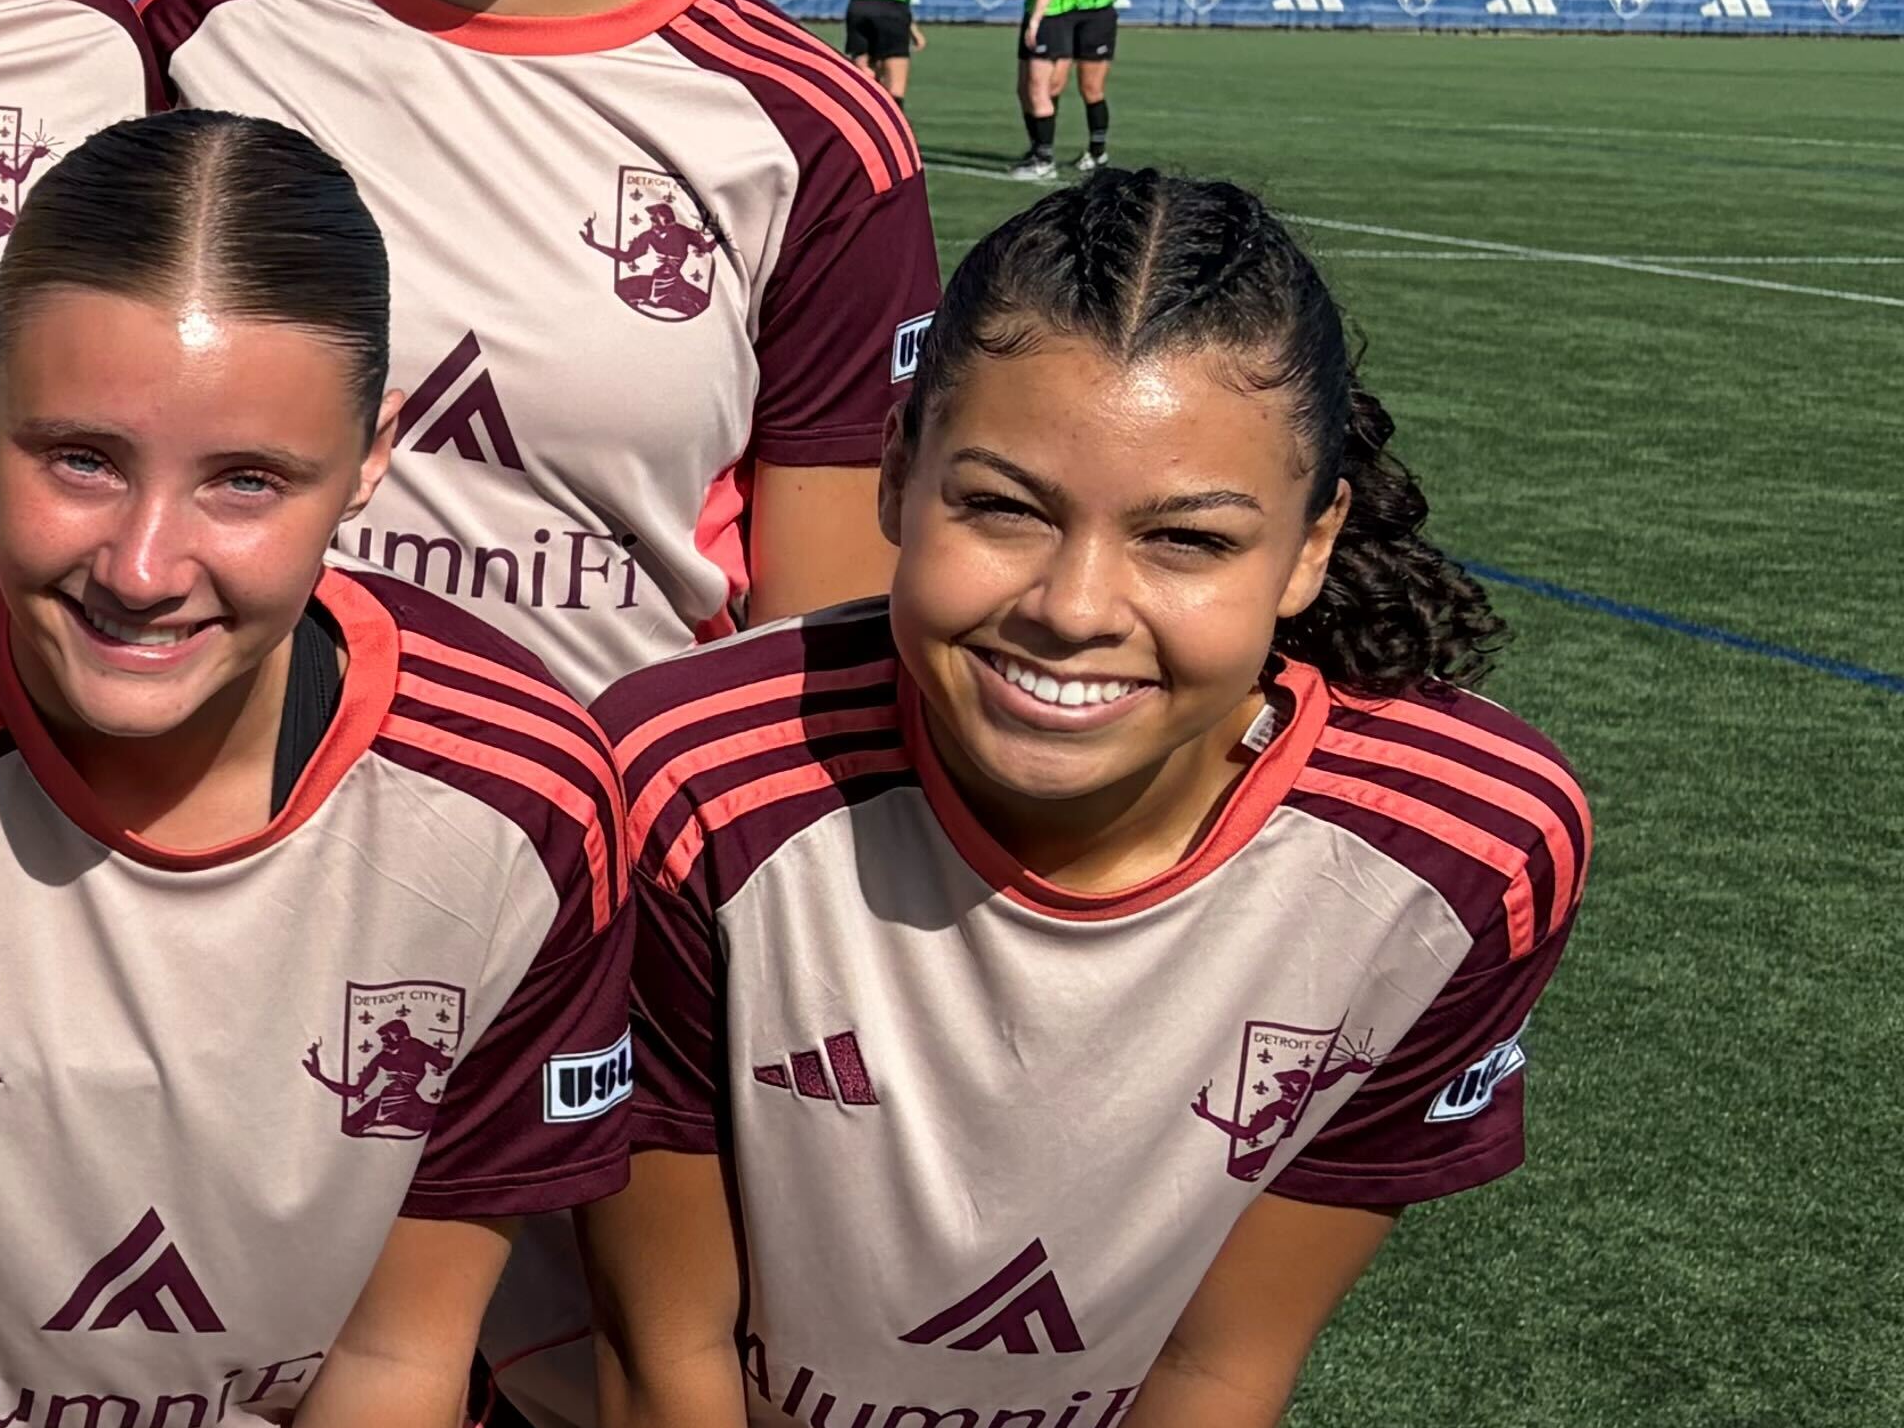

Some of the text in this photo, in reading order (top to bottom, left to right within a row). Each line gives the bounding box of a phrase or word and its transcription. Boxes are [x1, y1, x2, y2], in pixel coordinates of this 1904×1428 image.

[331, 527, 639, 610] mniFi
[354, 990, 457, 1007] DETROIT CITY FC
[1254, 1032, 1312, 1050] DETROIT
